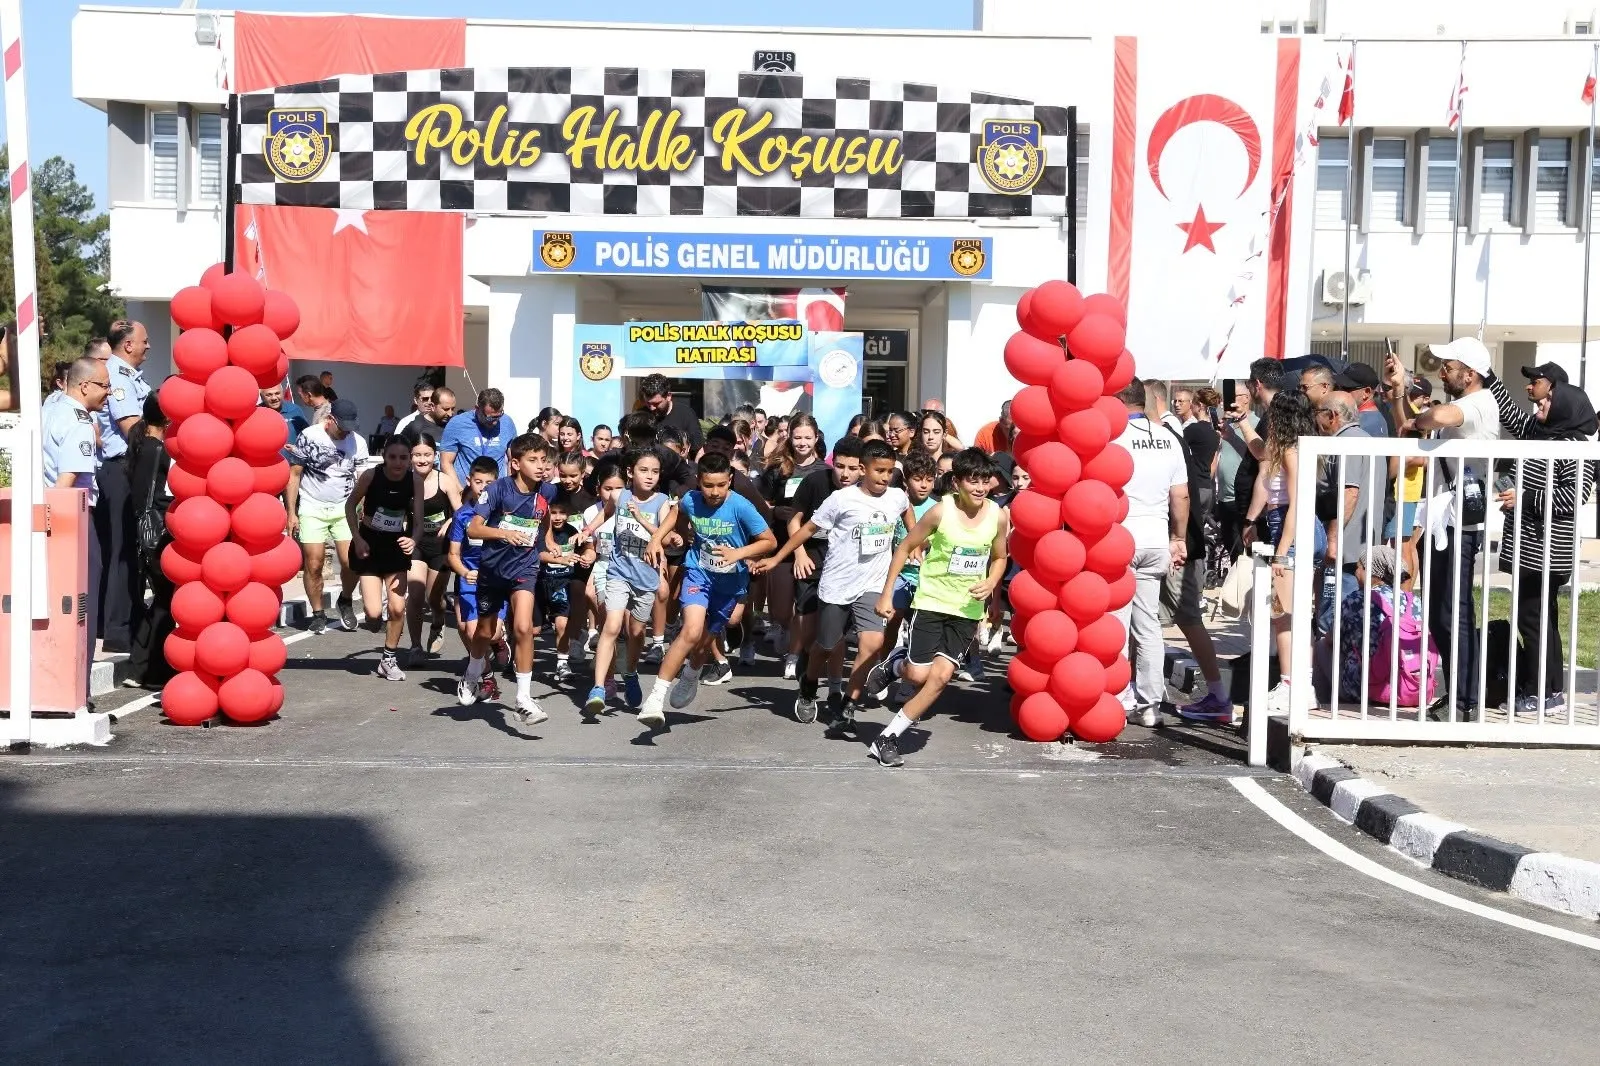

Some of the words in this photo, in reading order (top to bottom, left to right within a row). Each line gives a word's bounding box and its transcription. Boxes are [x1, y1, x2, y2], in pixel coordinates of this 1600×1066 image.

[278, 111, 316, 122] POLİS
[992, 124, 1031, 134] POLİS
[404, 103, 541, 167] Polis
[562, 105, 697, 171] Halk
[712, 108, 904, 179] Koşusu
[595, 235, 669, 268] POLİS
[677, 243, 760, 269] GENEL
[768, 239, 930, 272] MÜDÜRLÜĞÜ
[630, 323, 680, 342] POLİS
[683, 325, 731, 341] HALK
[731, 325, 802, 343] KOŞUSU
[676, 347, 756, 363] HATIRASI
[1131, 439, 1171, 450] HAKEM
[626, 522, 640, 532] 012
[874, 538, 885, 547] 021
[964, 560, 978, 569] 044
